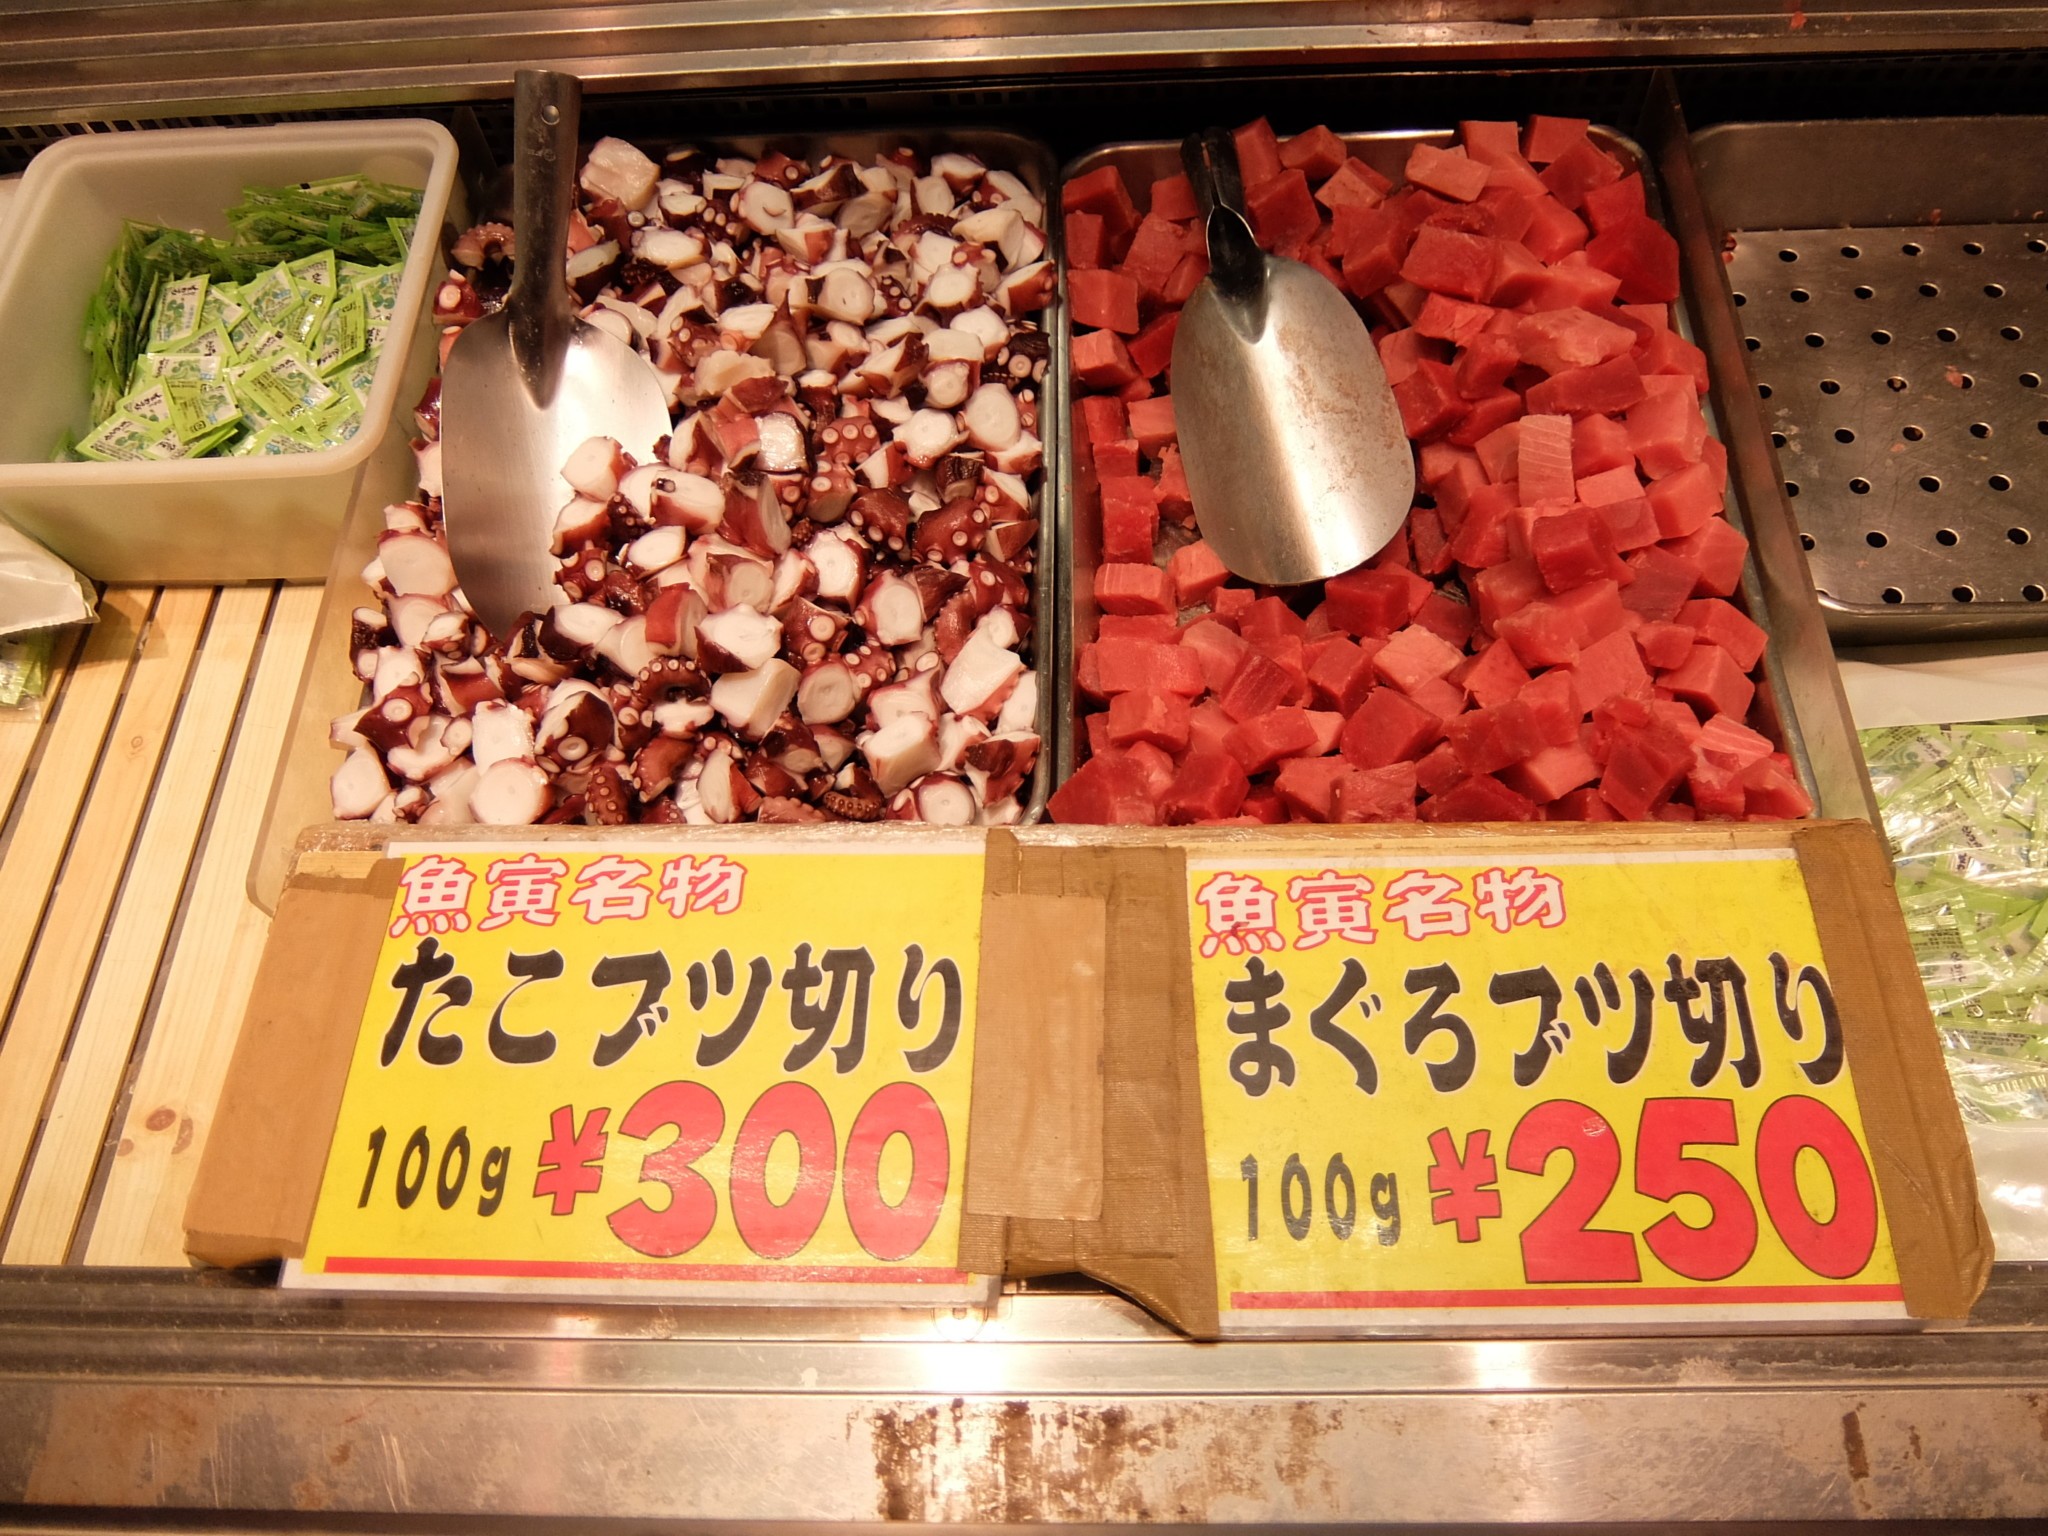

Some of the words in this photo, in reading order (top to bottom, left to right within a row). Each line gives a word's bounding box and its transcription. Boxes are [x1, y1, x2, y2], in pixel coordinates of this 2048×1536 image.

[389, 853, 747, 938] 魚寅名物
[1198, 867, 1568, 957] 魚寅名物
[380, 937, 962, 1073] たこブツ切り
[1224, 952, 1845, 1096] まぐろブツ切り
[357, 1124, 509, 1217] 100g
[533, 1080, 949, 1261] ¥300
[1241, 1151, 1400, 1246] 100g
[1428, 1094, 1877, 1285] ¥250
